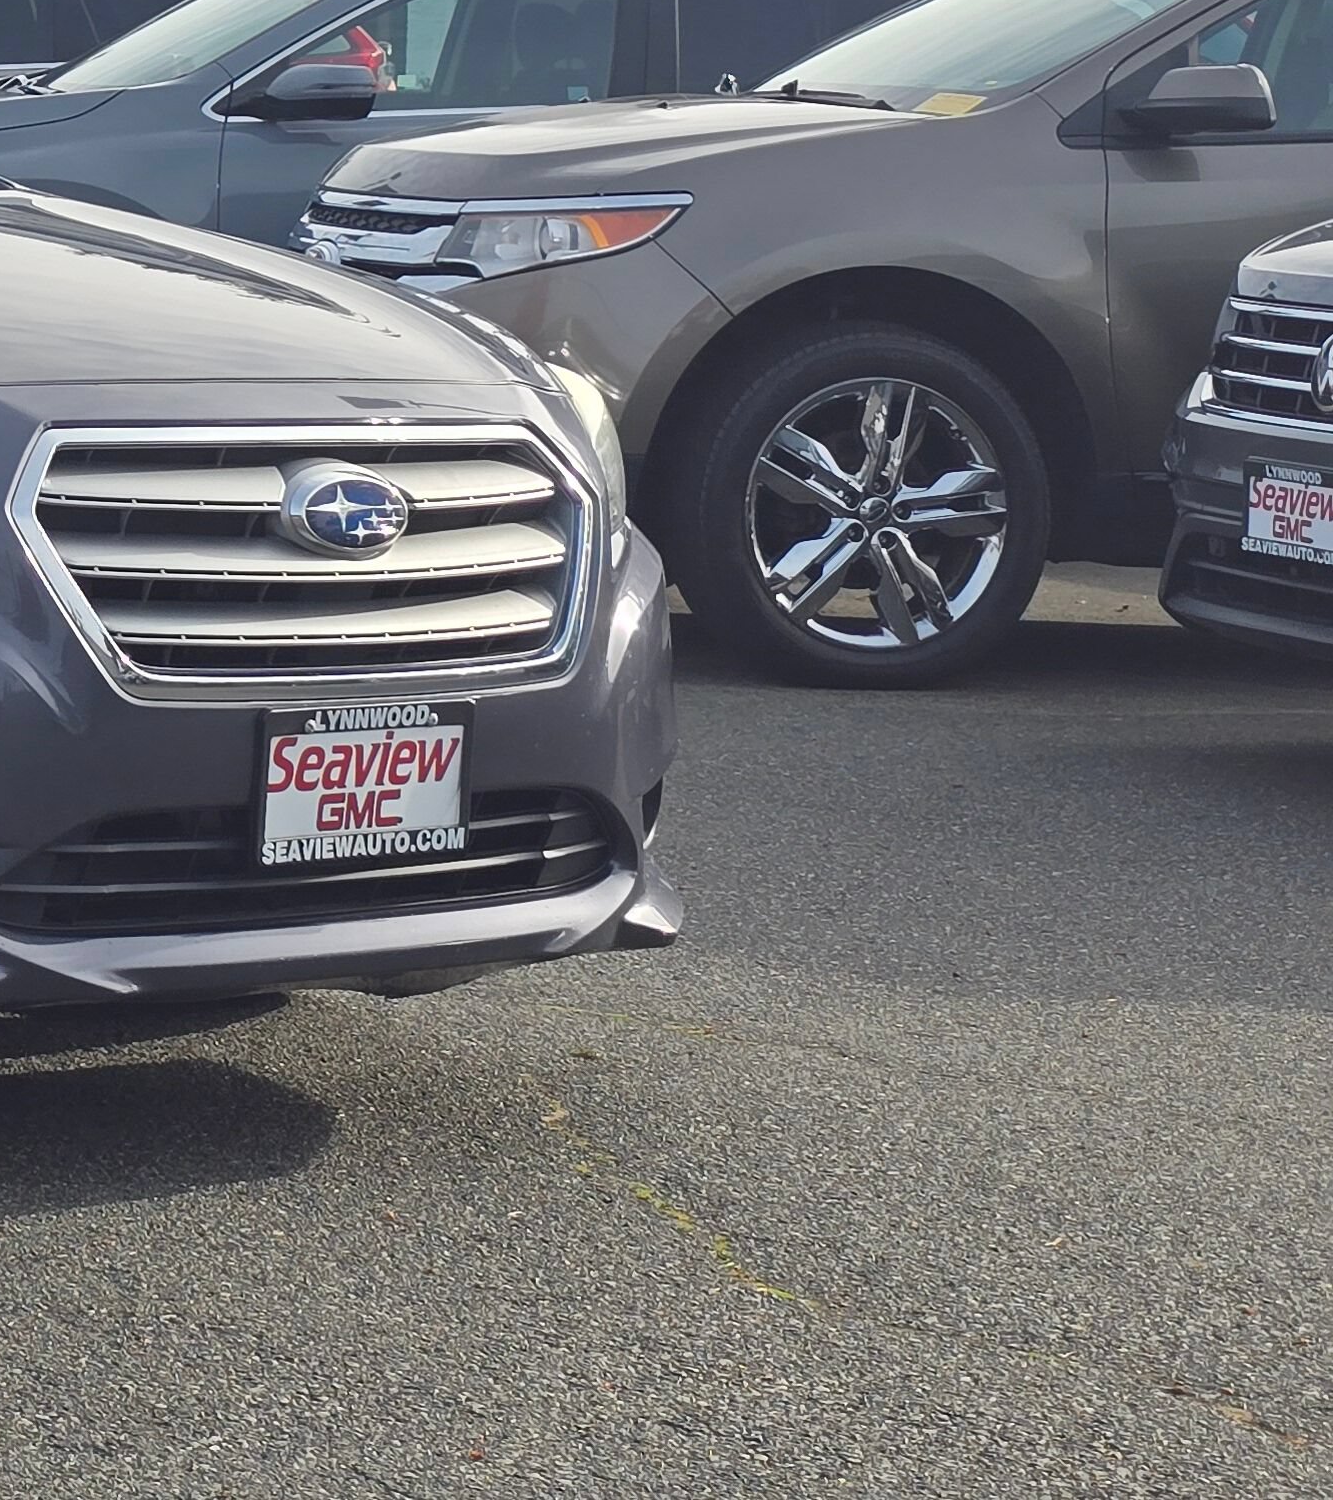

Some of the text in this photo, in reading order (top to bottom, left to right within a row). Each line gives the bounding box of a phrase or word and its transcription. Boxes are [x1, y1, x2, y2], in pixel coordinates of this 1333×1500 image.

[1265, 464, 1322, 485] LYNNWOOD
[1249, 477, 1333, 522] Seaview
[1272, 514, 1314, 544] GMC
[1241, 536, 1333, 565] SEAVIEWAUTO.CO
[314, 704, 430, 731] LYNNWOOD
[266, 730, 460, 793] Seaview
[316, 789, 402, 831] GMC
[262, 827, 465, 866] SEAVIEWAUTO.COM
